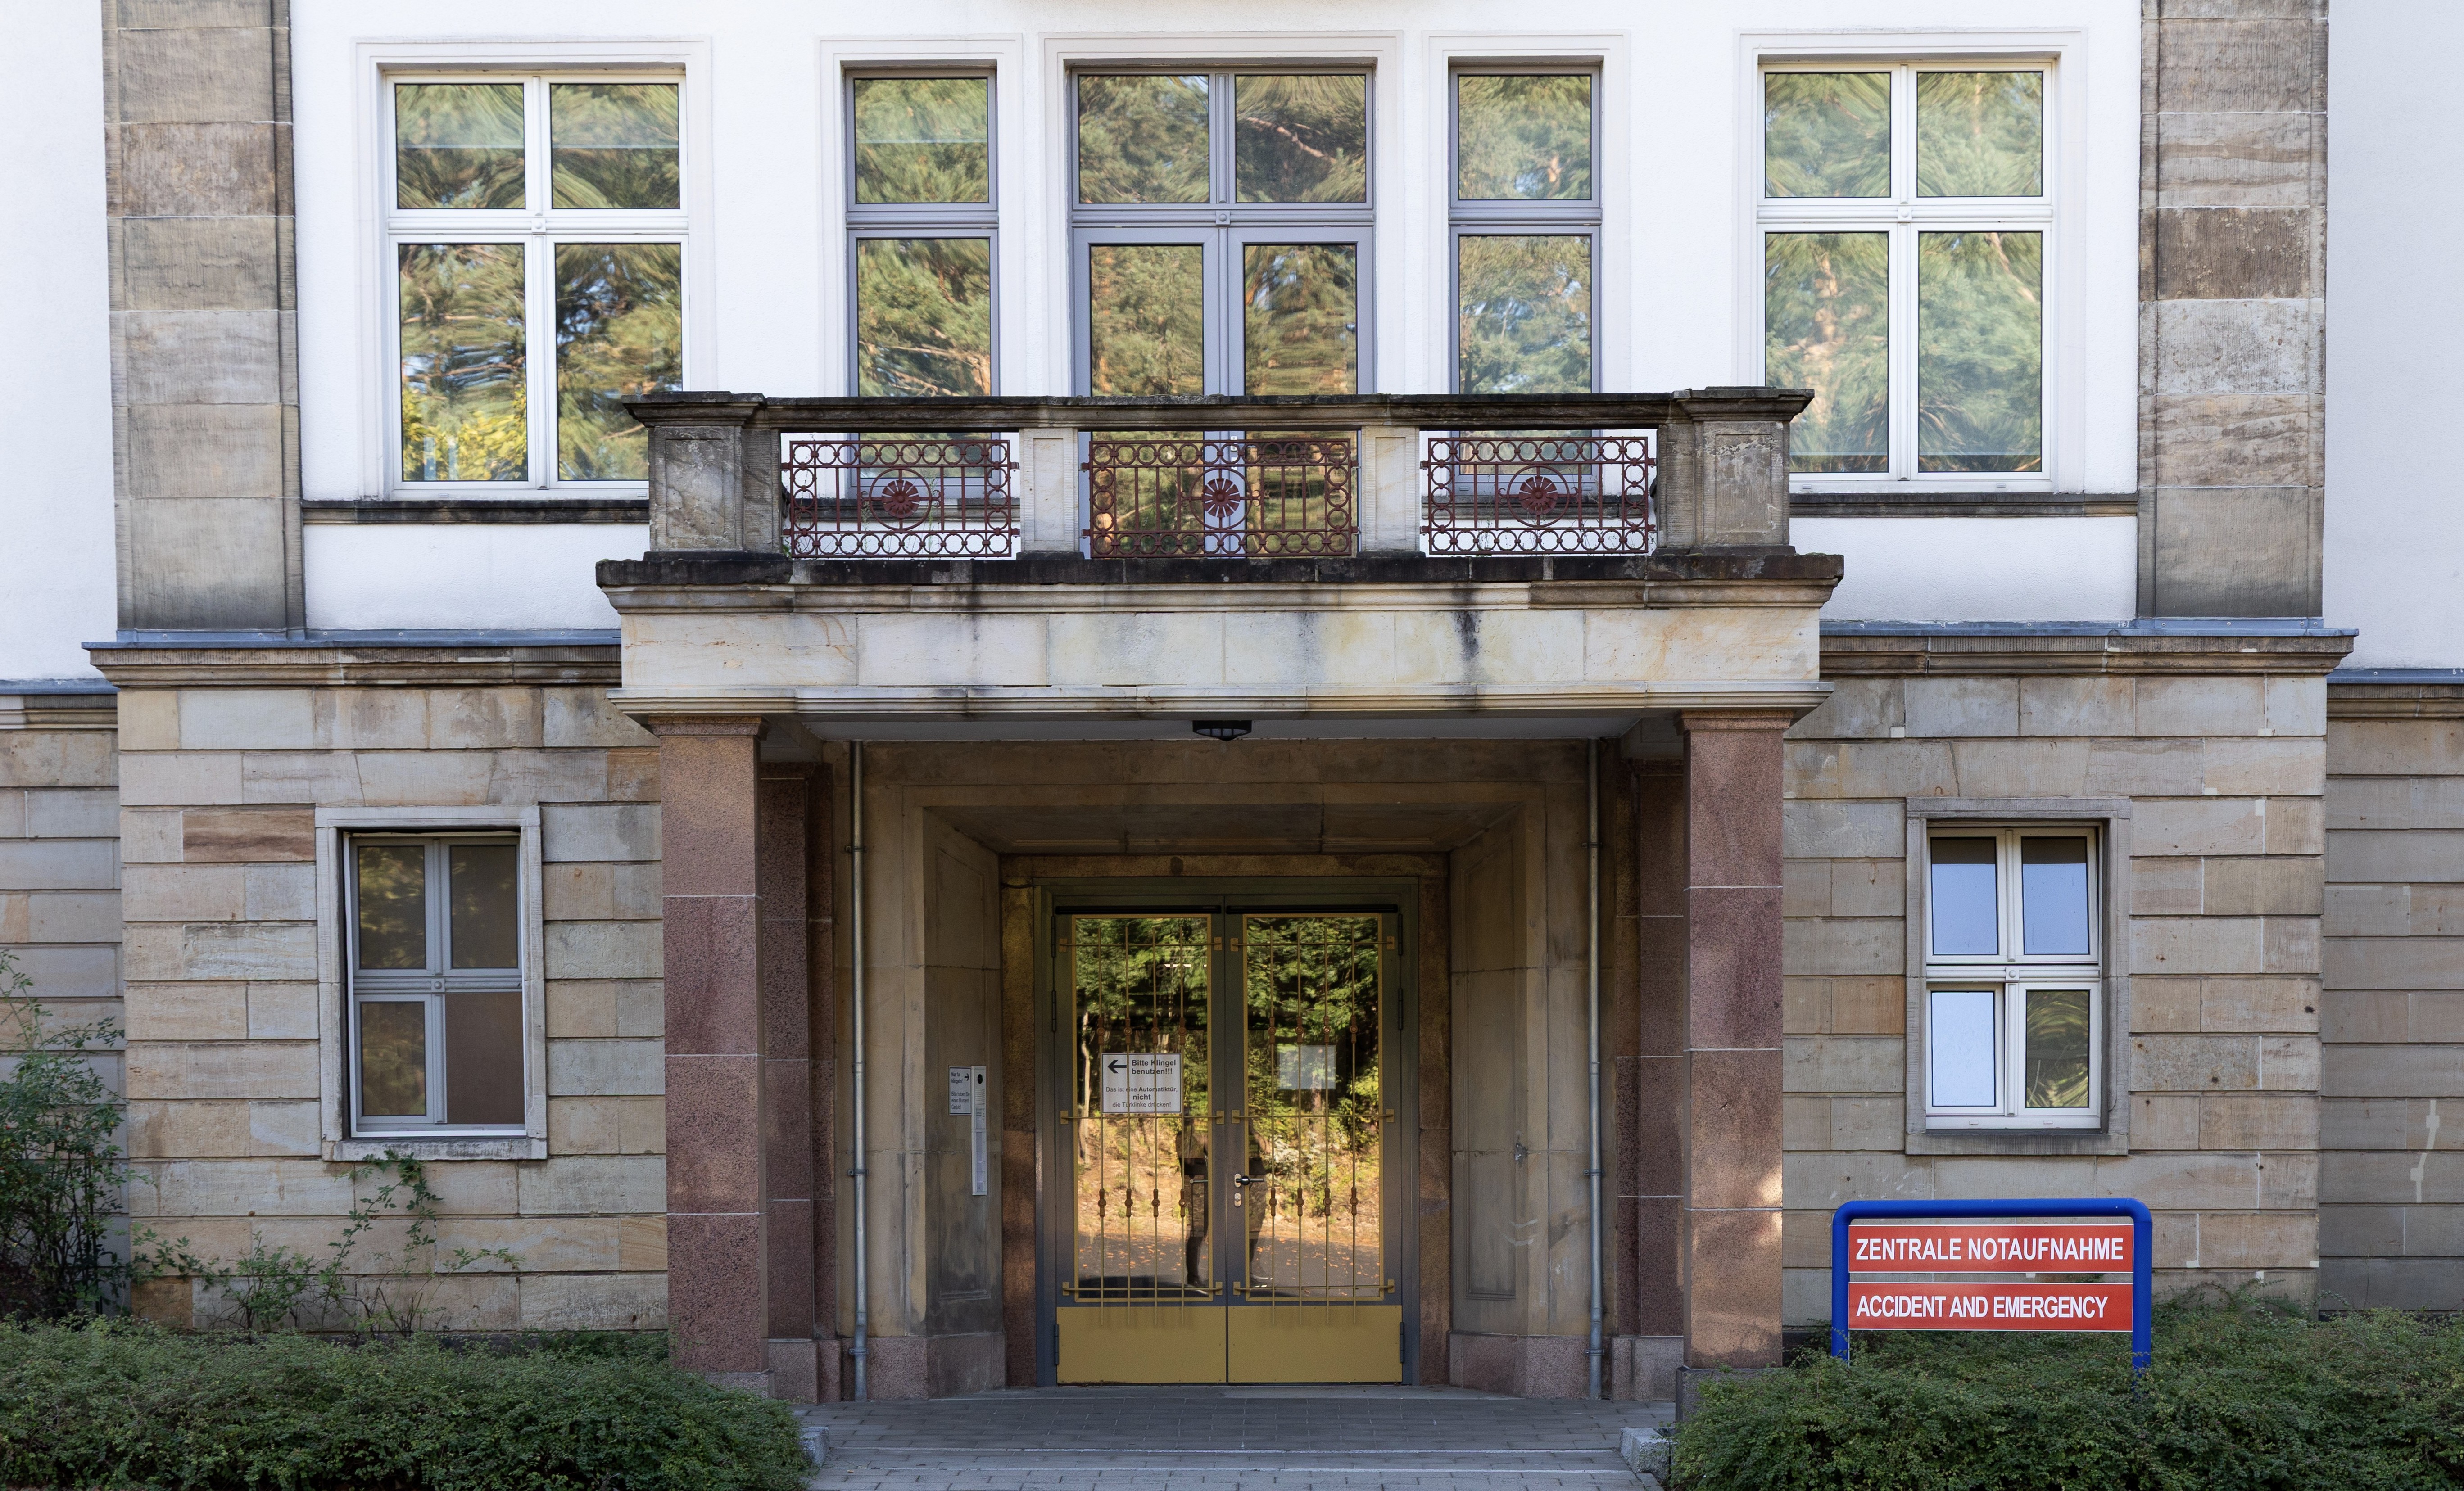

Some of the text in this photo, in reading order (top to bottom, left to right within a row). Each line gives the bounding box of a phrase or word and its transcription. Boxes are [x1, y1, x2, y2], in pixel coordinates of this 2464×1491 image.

[1150, 1059, 1176, 1067] Klingel
[1856, 1238, 2124, 1260] ZENTRALE NOTAUFNAHME
[1856, 1295, 2109, 1318] ACCIDENT AND EMERGENCY
